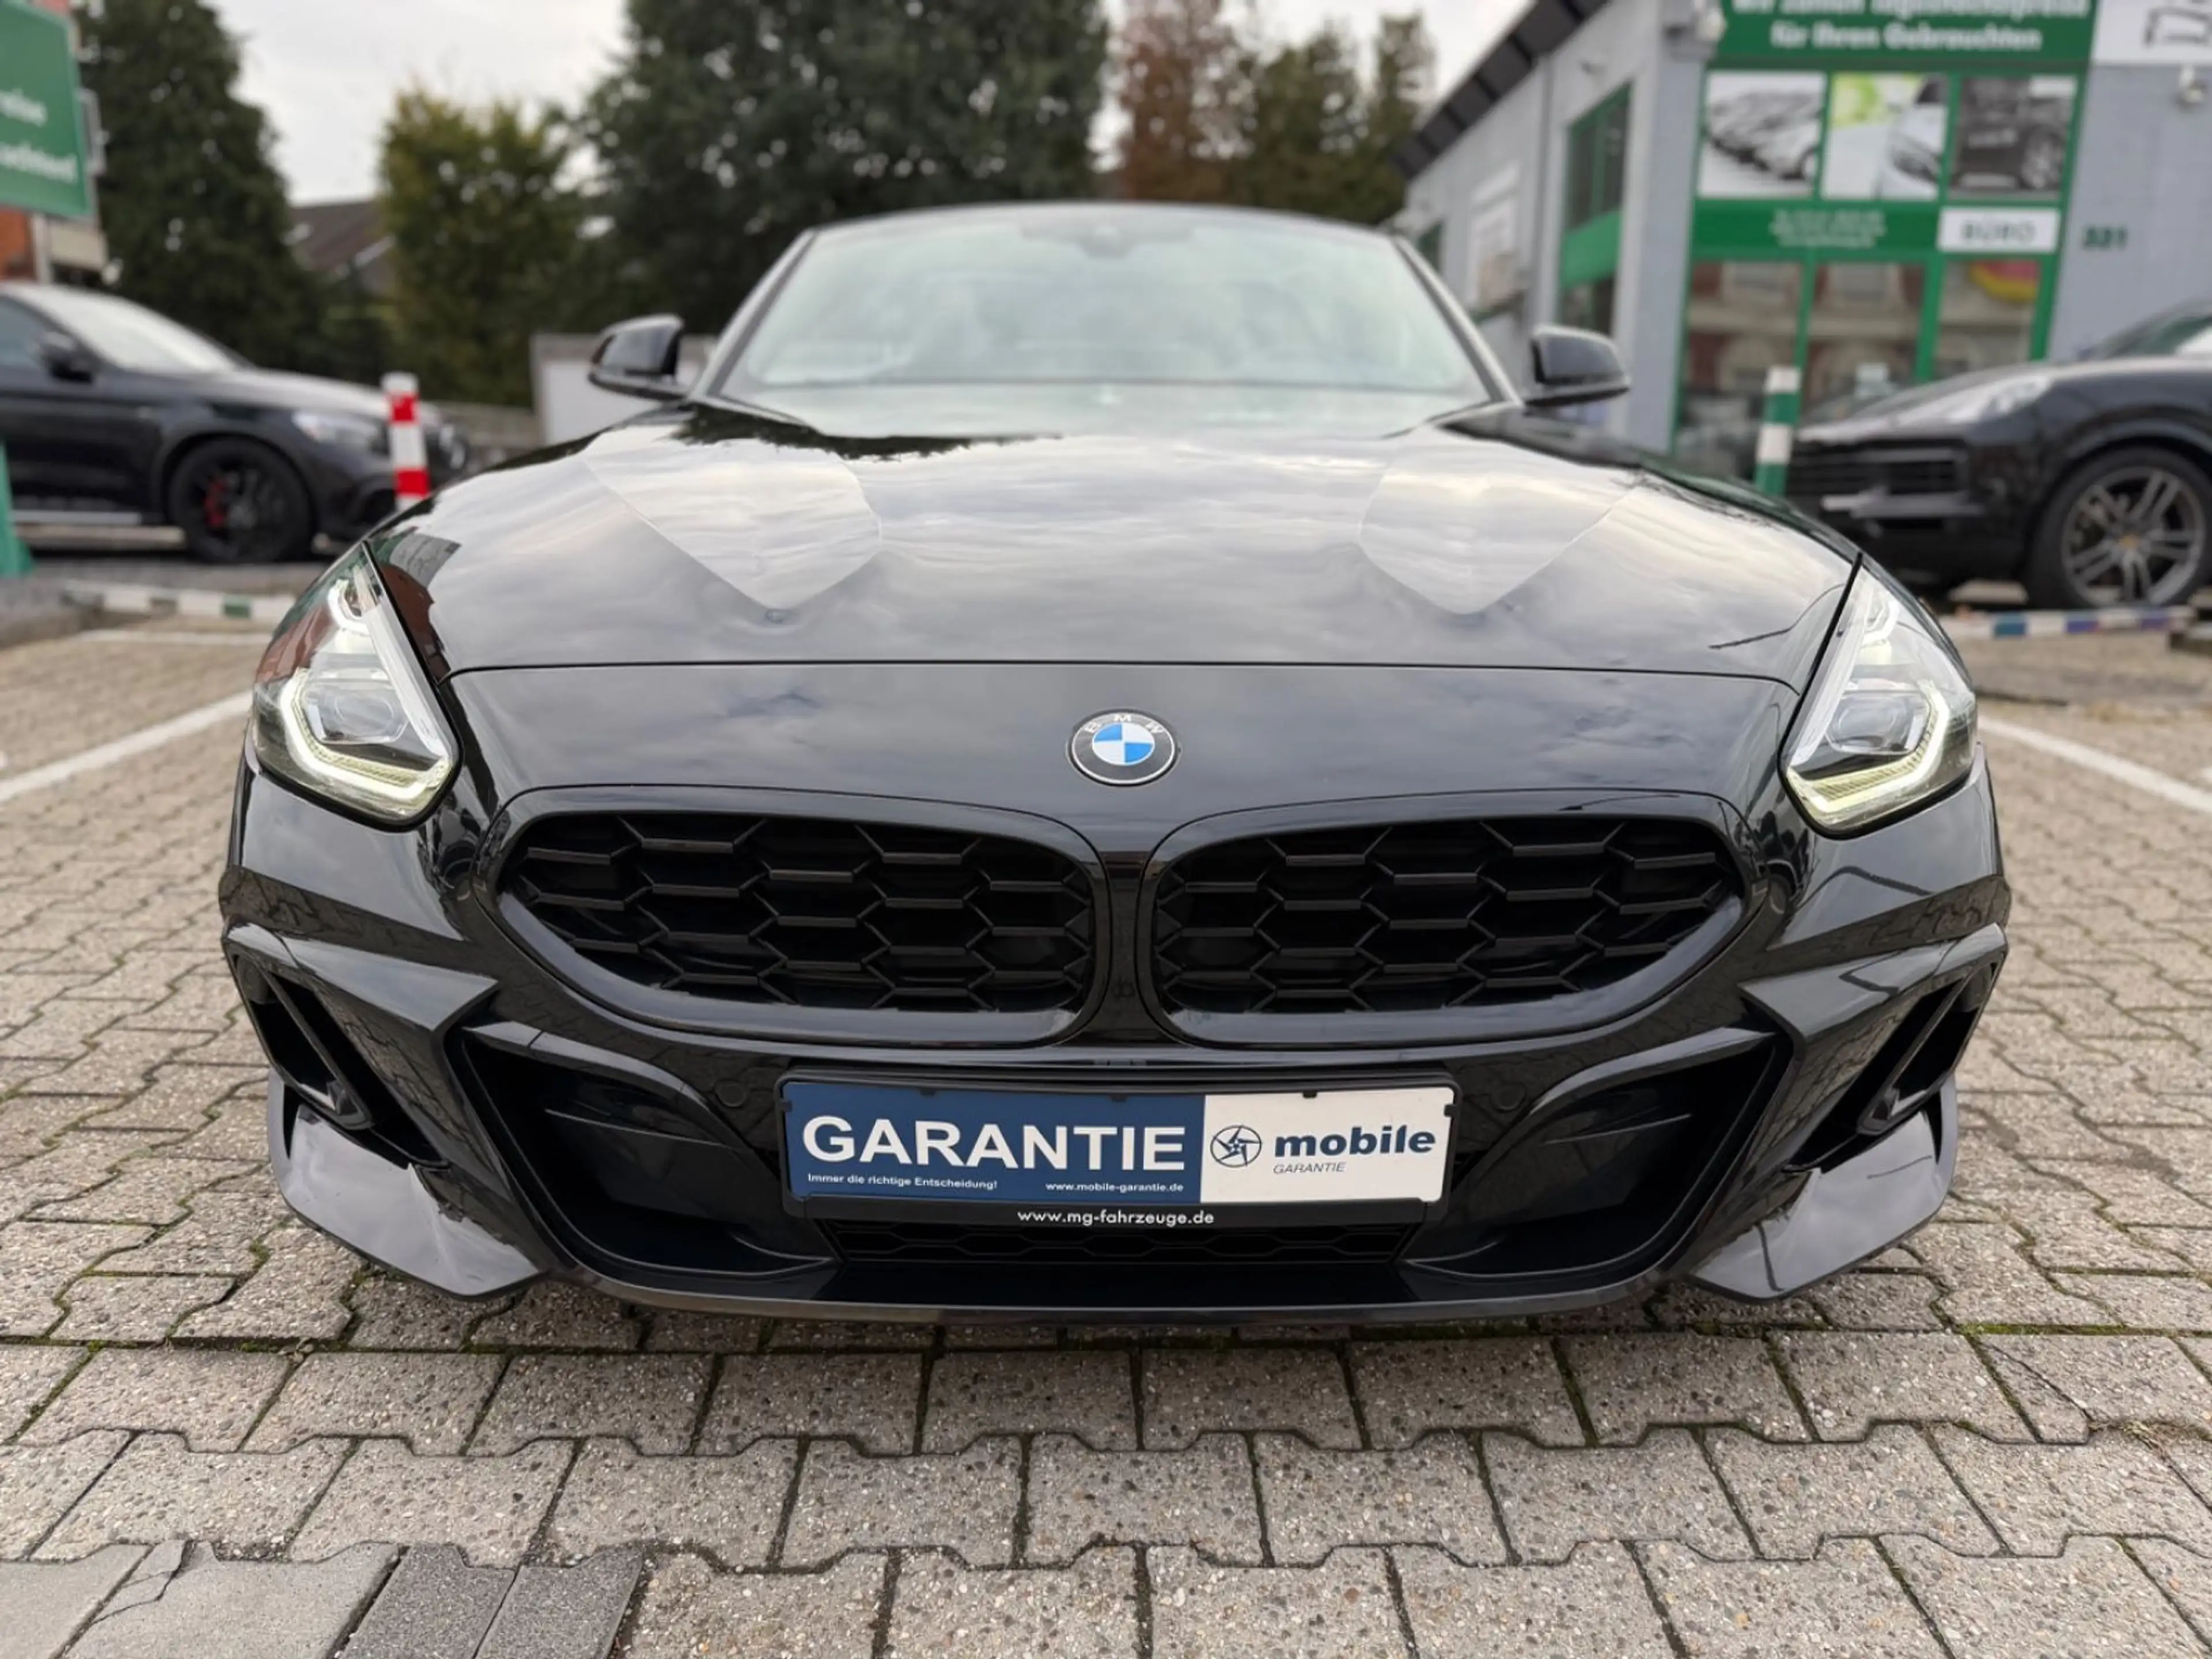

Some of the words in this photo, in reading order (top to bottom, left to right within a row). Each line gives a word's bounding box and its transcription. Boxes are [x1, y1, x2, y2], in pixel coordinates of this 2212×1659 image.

[802, 1115, 1185, 1171] GARANTIE
[1274, 1125, 1436, 1158] mobile
[1272, 1161, 1346, 1175] GARANTIE
[808, 1173, 844, 1183] Immer
[847, 1174, 865, 1184] die
[868, 1175, 911, 1188] richtige
[914, 1176, 998, 1190] Entscheidung!
[1045, 1181, 1184, 1194] www.mobile-garantie.de
[1017, 1209, 1214, 1228] www.mg-fahrzeuge.de
